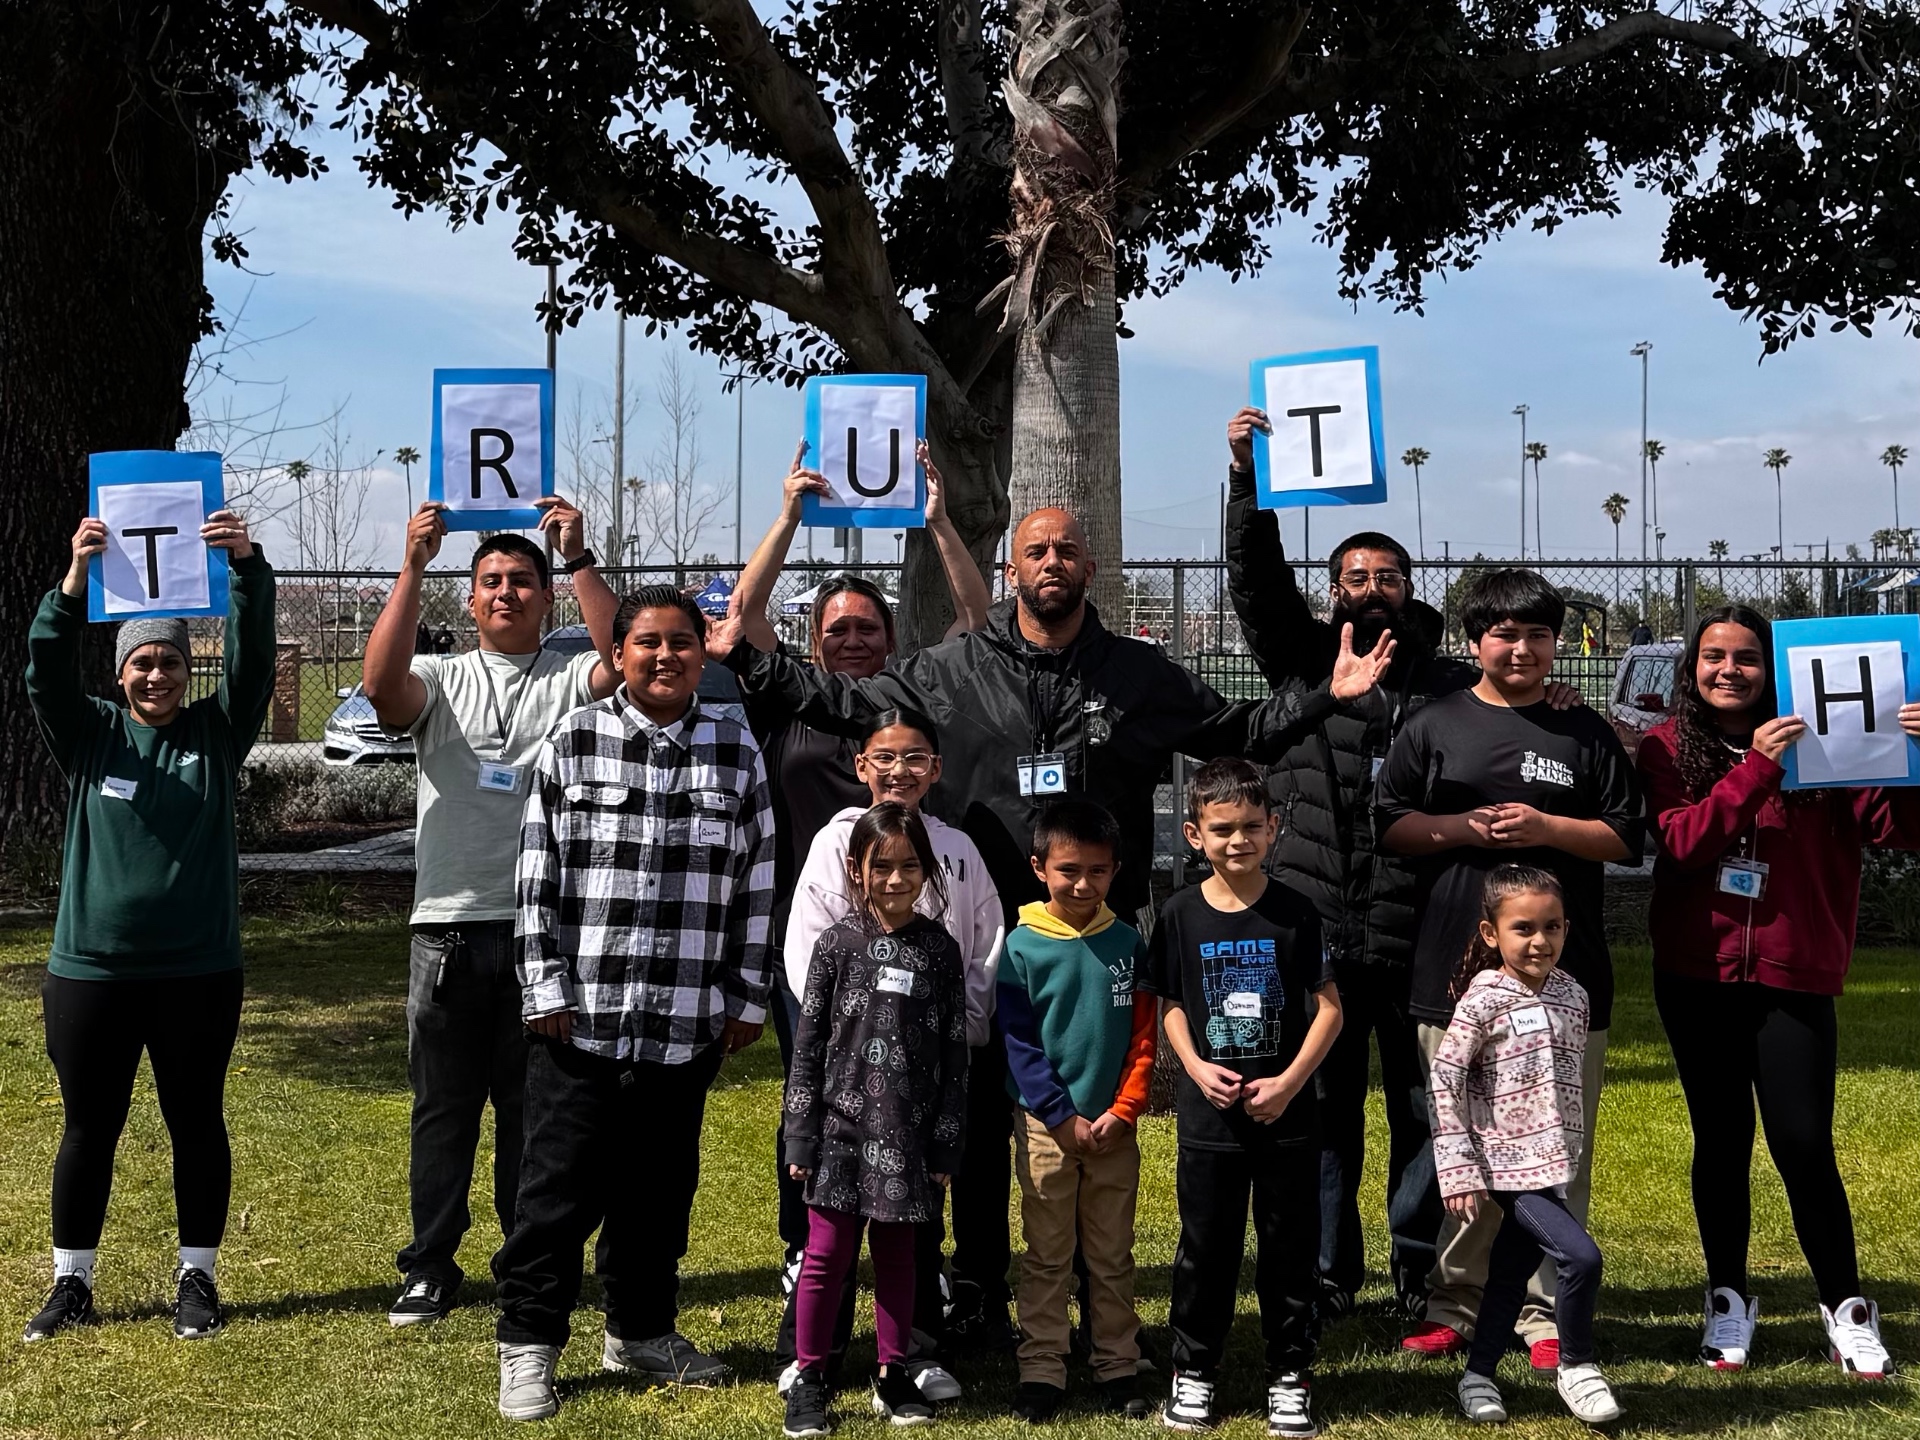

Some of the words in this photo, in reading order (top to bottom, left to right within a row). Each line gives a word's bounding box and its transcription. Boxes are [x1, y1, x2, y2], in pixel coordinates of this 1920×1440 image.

[470, 427, 520, 500] R
[847, 427, 900, 498] U
[1287, 405, 1342, 477] T
[121, 526, 179, 600] T
[1811, 655, 1876, 736] H
[1200, 939, 1276, 958] GAME
[1241, 955, 1275, 965] OVER
